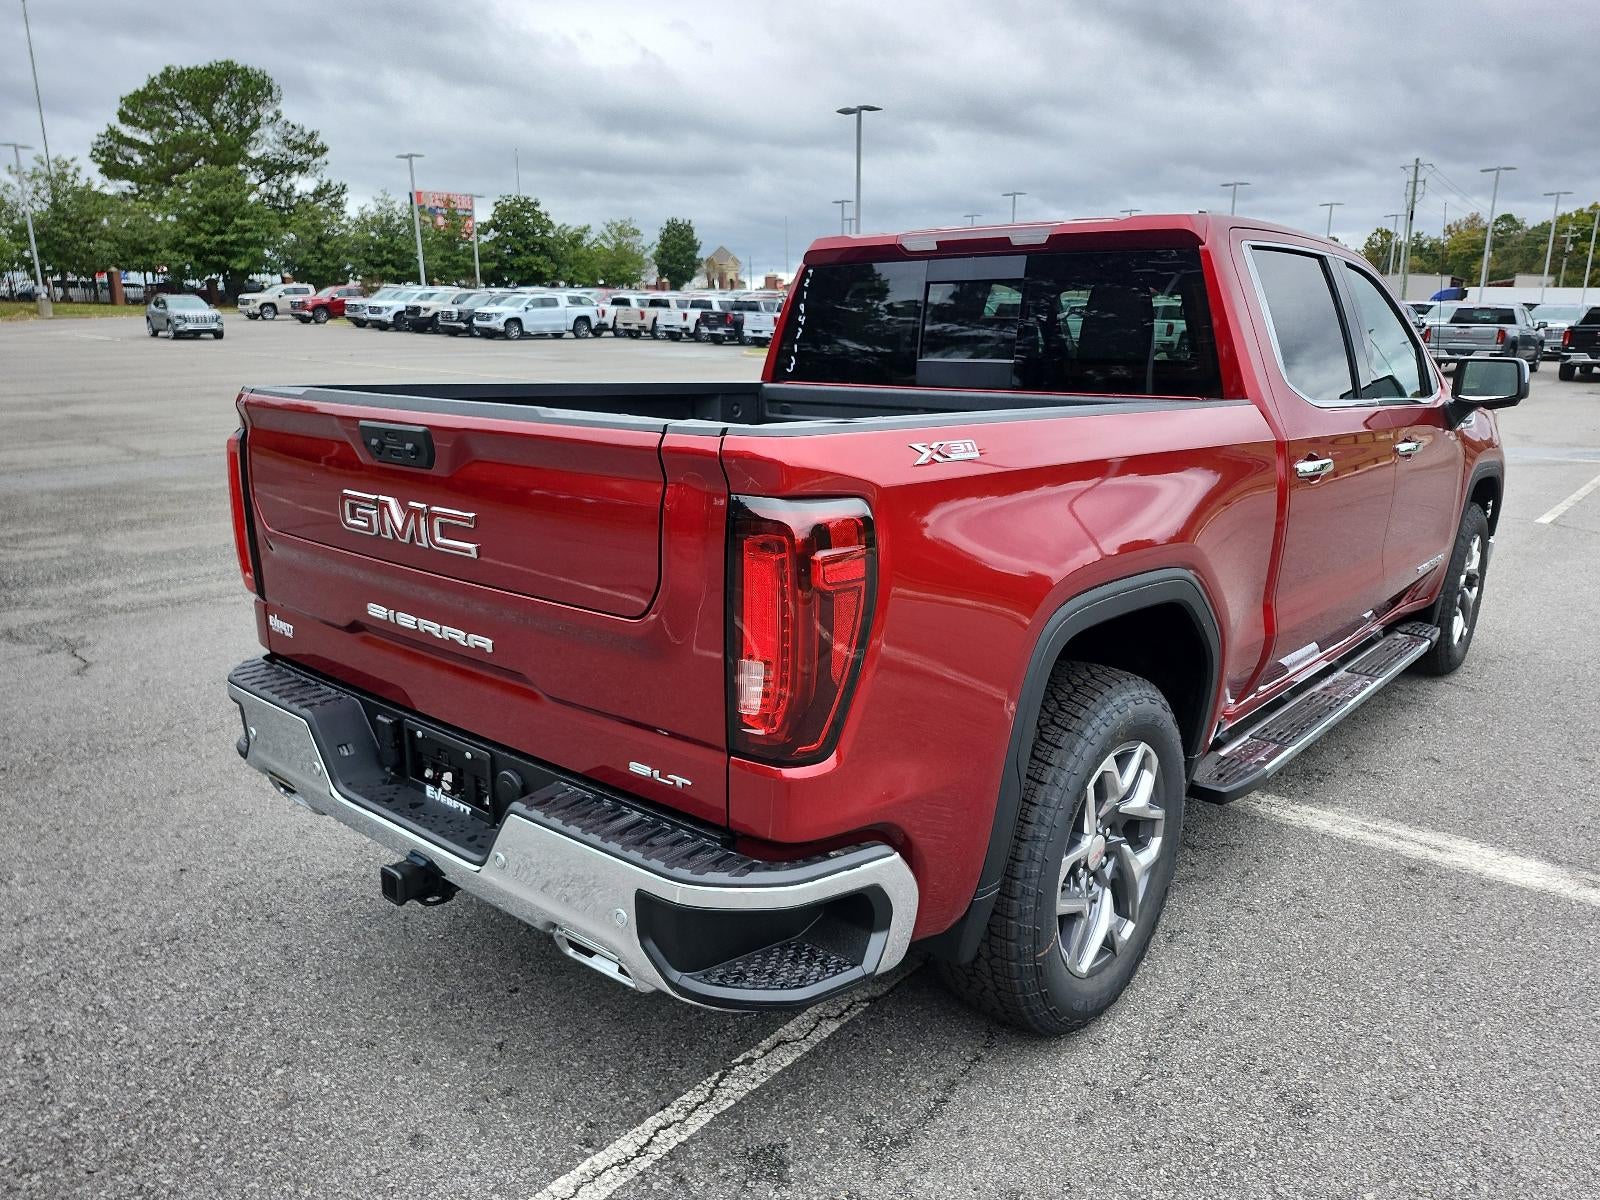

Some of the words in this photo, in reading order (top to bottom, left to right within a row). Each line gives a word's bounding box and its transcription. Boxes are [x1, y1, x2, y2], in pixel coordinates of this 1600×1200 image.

[908, 440, 981, 466] X31
[339, 488, 481, 559] GMC
[366, 602, 494, 653] SIERRA
[629, 761, 692, 789] SLT
